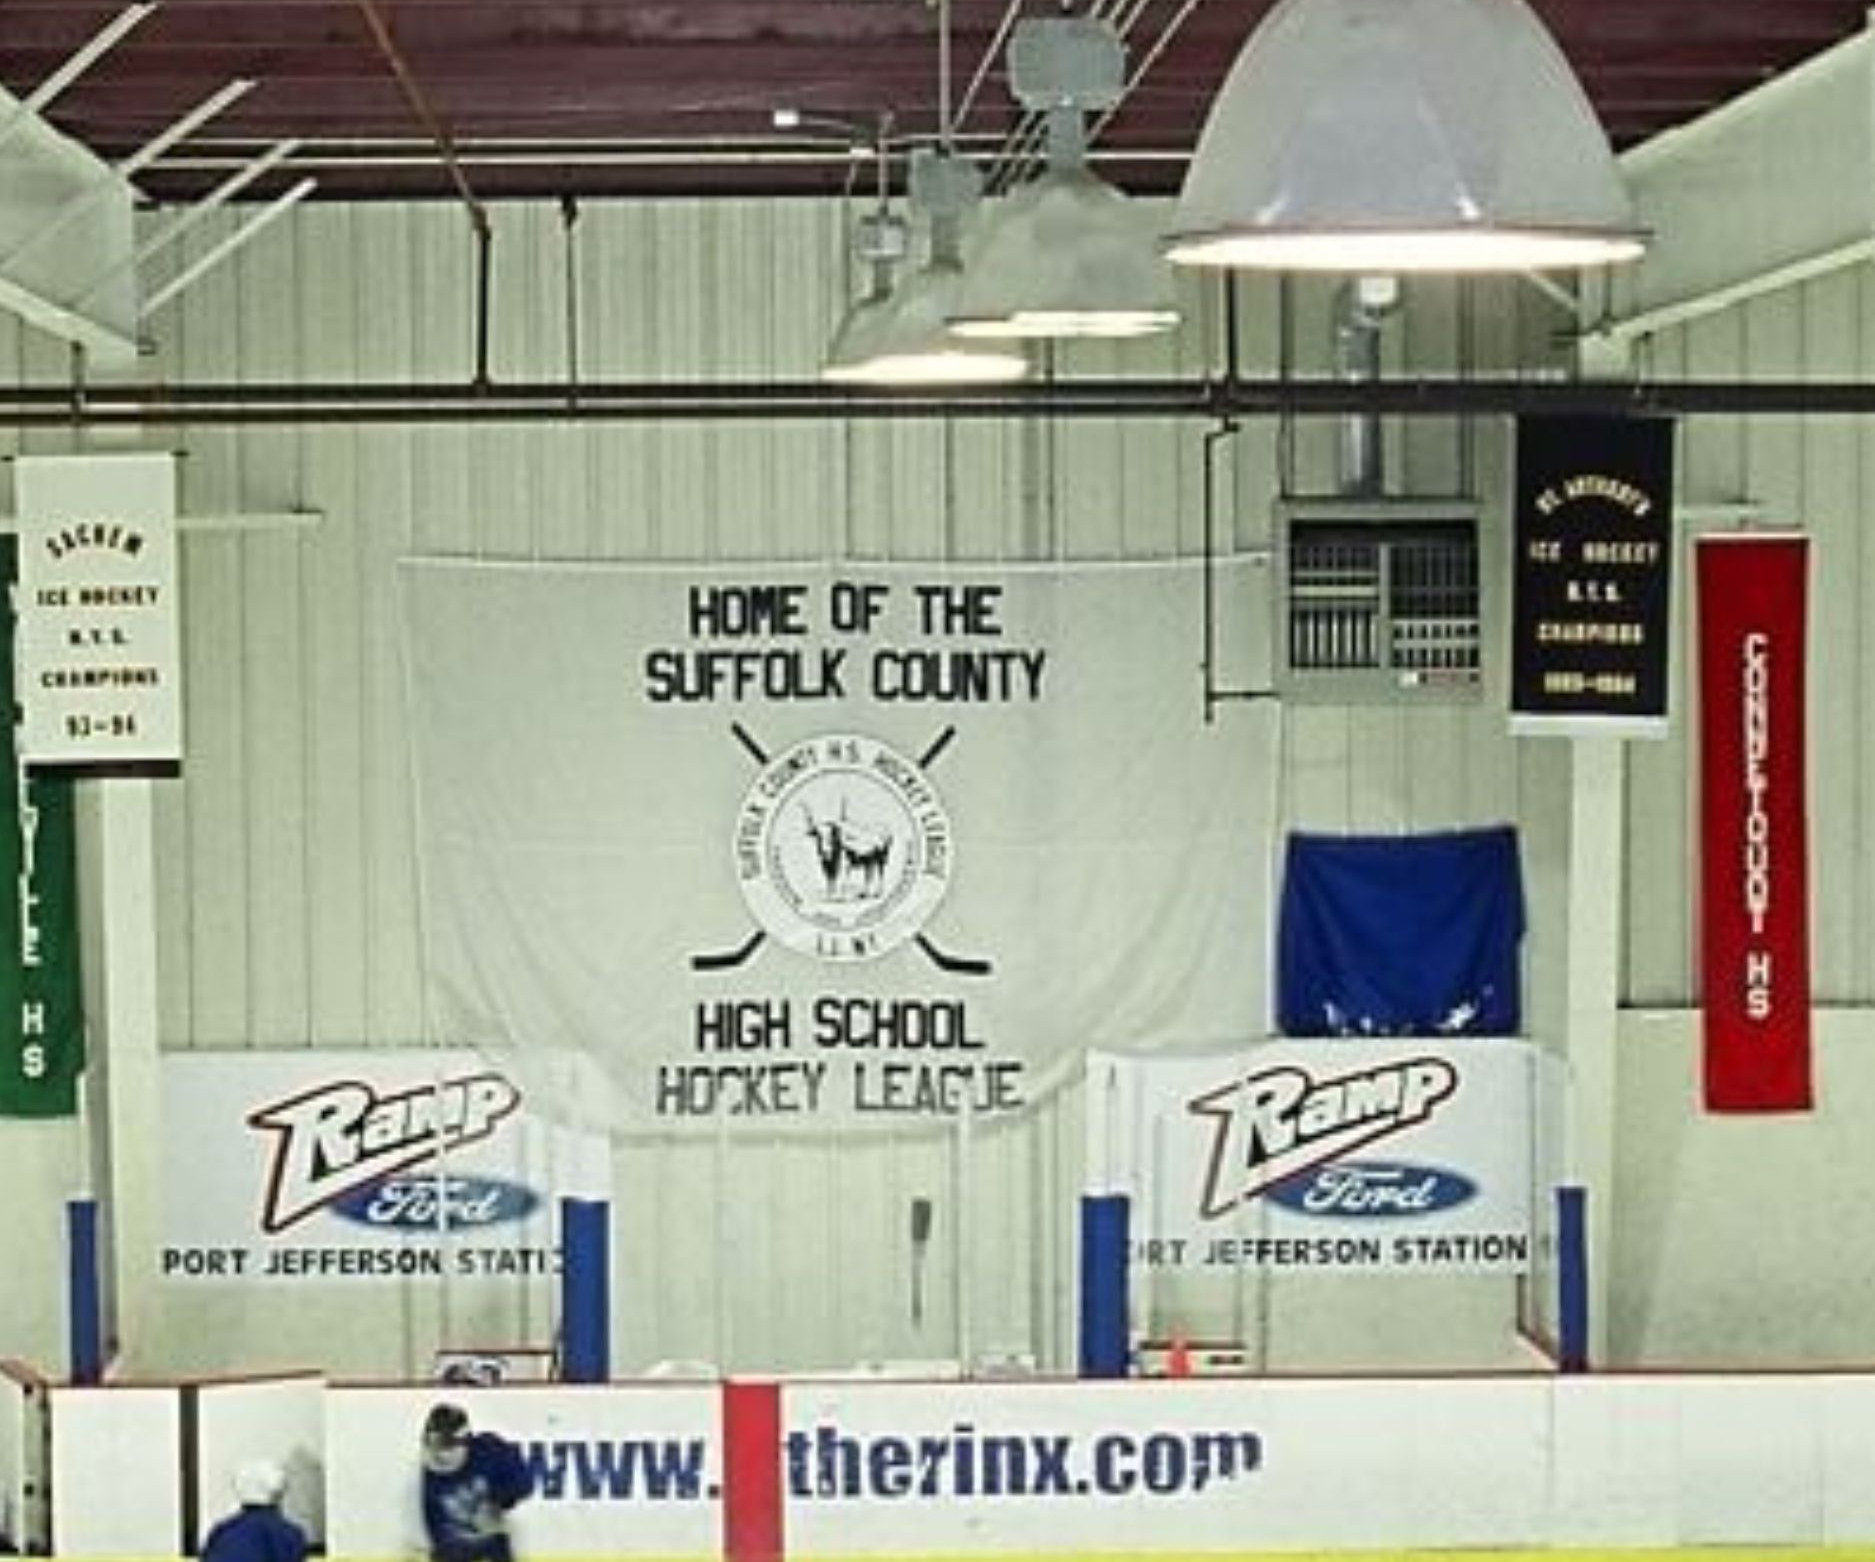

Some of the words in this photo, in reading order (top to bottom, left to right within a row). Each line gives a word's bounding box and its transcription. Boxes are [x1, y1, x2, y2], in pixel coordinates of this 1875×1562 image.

[46, 522, 144, 559] SACHEM
[1529, 540, 1561, 563] ICE
[1582, 540, 1660, 564] HOCKEY
[37, 587, 68, 607] ICE
[79, 586, 159, 607] HOCKEY
[688, 584, 808, 637] HOME
[830, 582, 890, 636] OF
[915, 585, 1004, 636] THE
[1537, 621, 1644, 645] CHAMPIONS
[41, 666, 160, 688] CHAMPIONS
[645, 648, 846, 702] SUFFOLK
[872, 648, 1046, 702] COUNTY
[1743, 633, 1770, 934] CONNETQUOT
[1746, 951, 1772, 1019] HS
[21, 1003, 46, 1079] HS
[696, 1001, 791, 1051] HIGH
[812, 997, 987, 1050] SCHOOL
[655, 1062, 826, 1117] HOCKEY
[853, 1062, 1026, 1116] LEAGUE
[365, 1180, 501, 1223] Ford
[1302, 1168, 1441, 1213] Ford
[161, 1248, 249, 1276] PORT
[264, 1248, 441, 1276] JEFFERSON
[1137, 1239, 1188, 1266] RT
[1202, 1238, 1382, 1266] JEFFERSON
[1392, 1234, 1528, 1263] STATION
